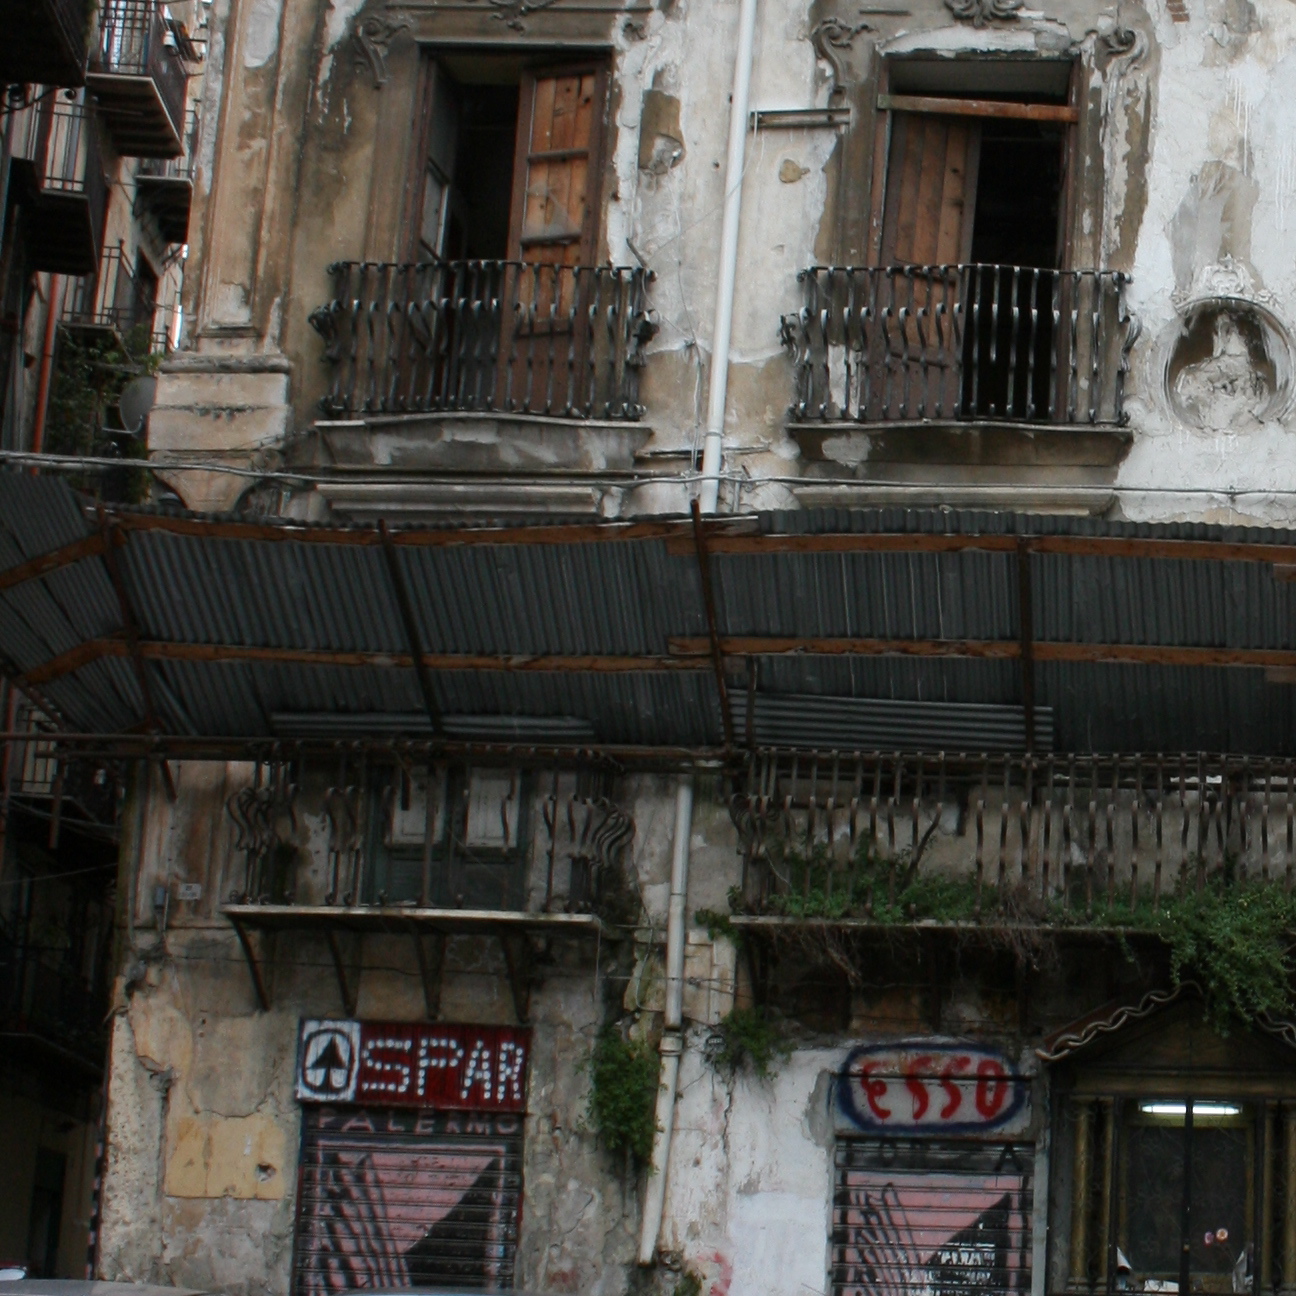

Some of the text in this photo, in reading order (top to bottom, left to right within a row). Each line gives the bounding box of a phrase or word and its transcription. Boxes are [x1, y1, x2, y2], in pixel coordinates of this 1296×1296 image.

[360, 1037, 523, 1102] SPAR
[859, 1056, 1008, 1122] ESSO
[316, 1107, 520, 1136] PALERMO
